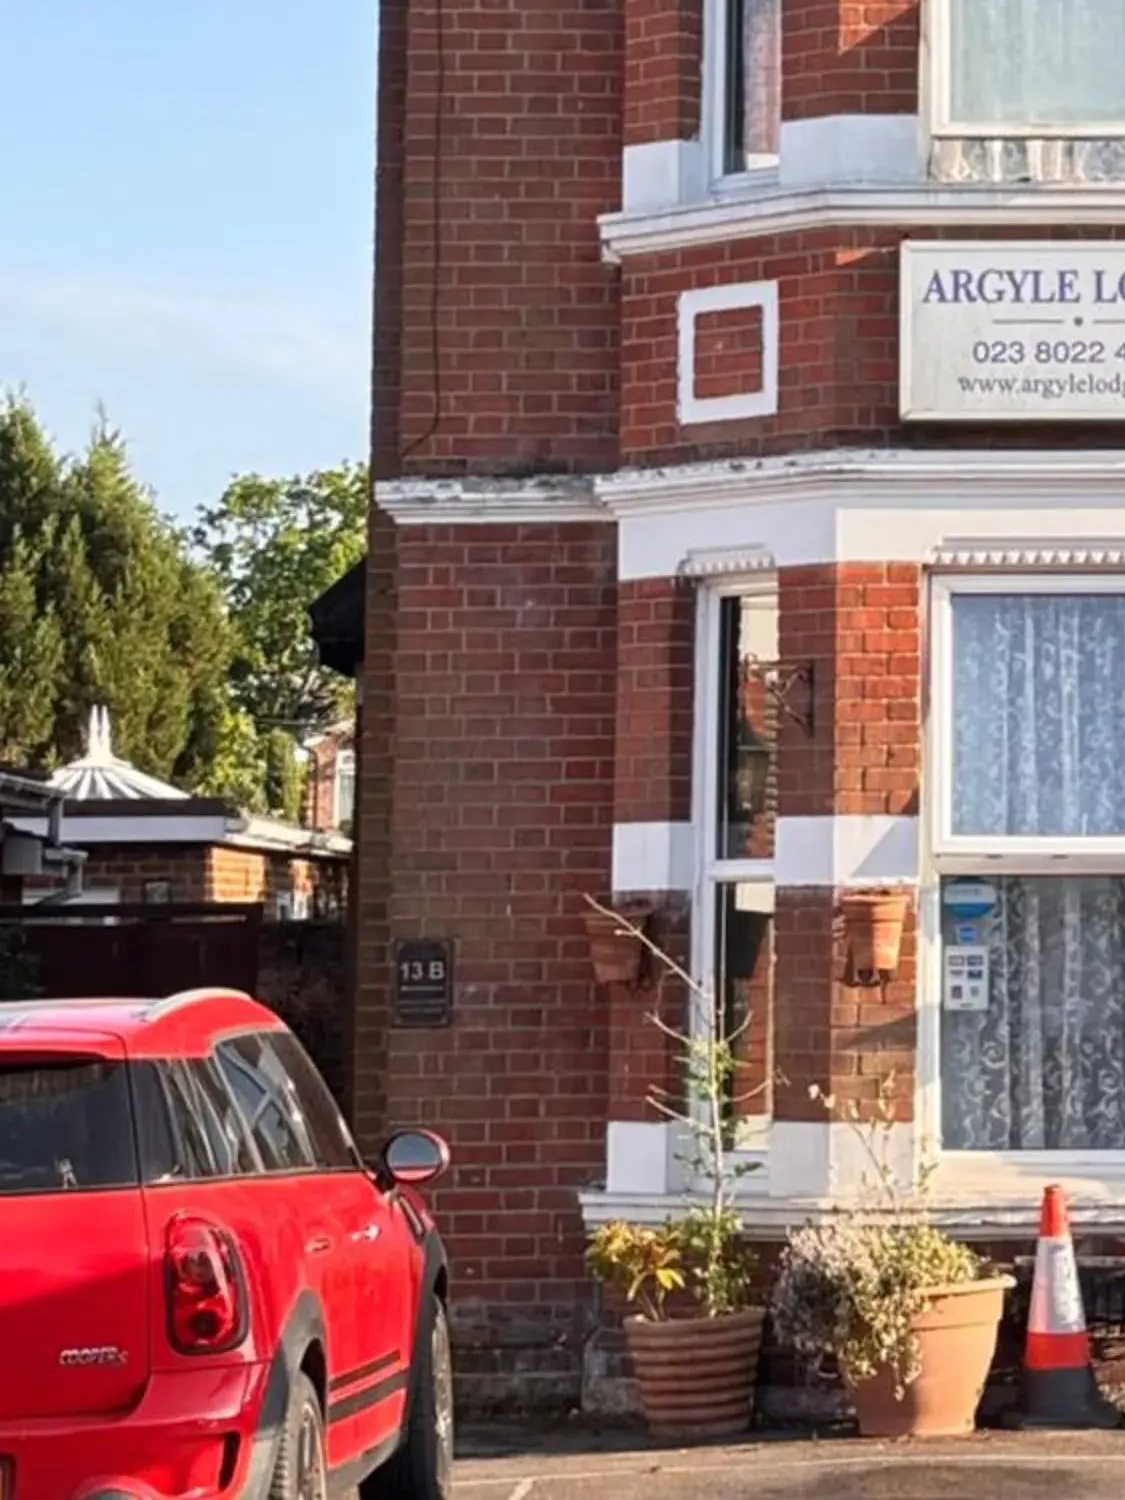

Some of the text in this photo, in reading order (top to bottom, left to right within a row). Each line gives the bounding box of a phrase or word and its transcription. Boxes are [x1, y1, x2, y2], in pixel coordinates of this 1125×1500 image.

[922, 268, 1081, 305] ARGYLE
[972, 341, 1025, 364] 023
[1034, 341, 1105, 364] 8022
[400, 961, 445, 980] 13 B
